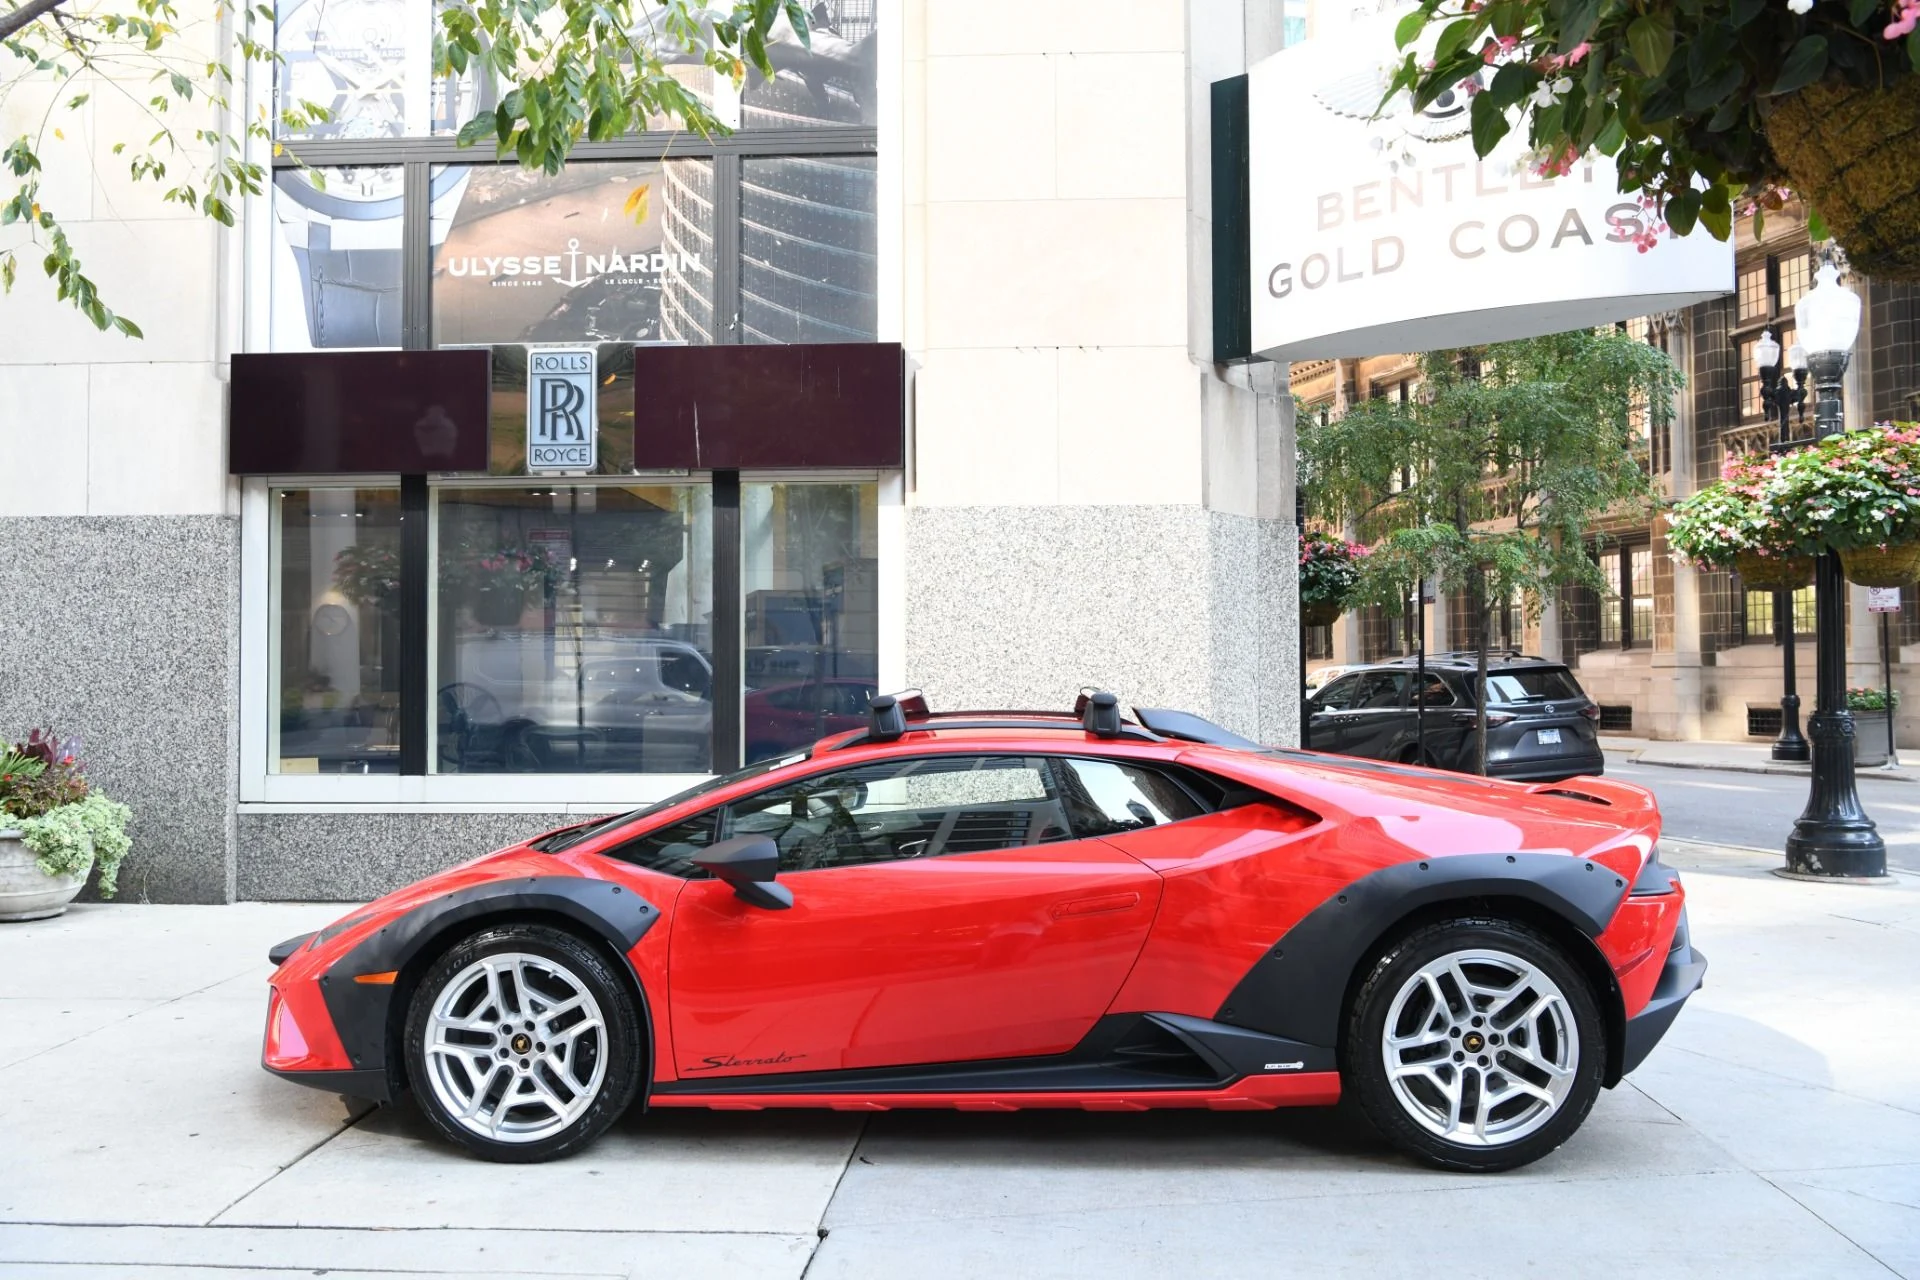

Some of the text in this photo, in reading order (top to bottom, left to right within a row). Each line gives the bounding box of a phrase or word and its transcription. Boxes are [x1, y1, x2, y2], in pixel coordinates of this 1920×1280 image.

[448, 253, 701, 277] ULYSSE NARDIN
[1268, 235, 1405, 299] GOLD
[535, 356, 588, 370] ROLLS
[539, 378, 585, 440] RR
[534, 448, 587, 463] ROYCE
[684, 1051, 807, 1071] Sterrato
